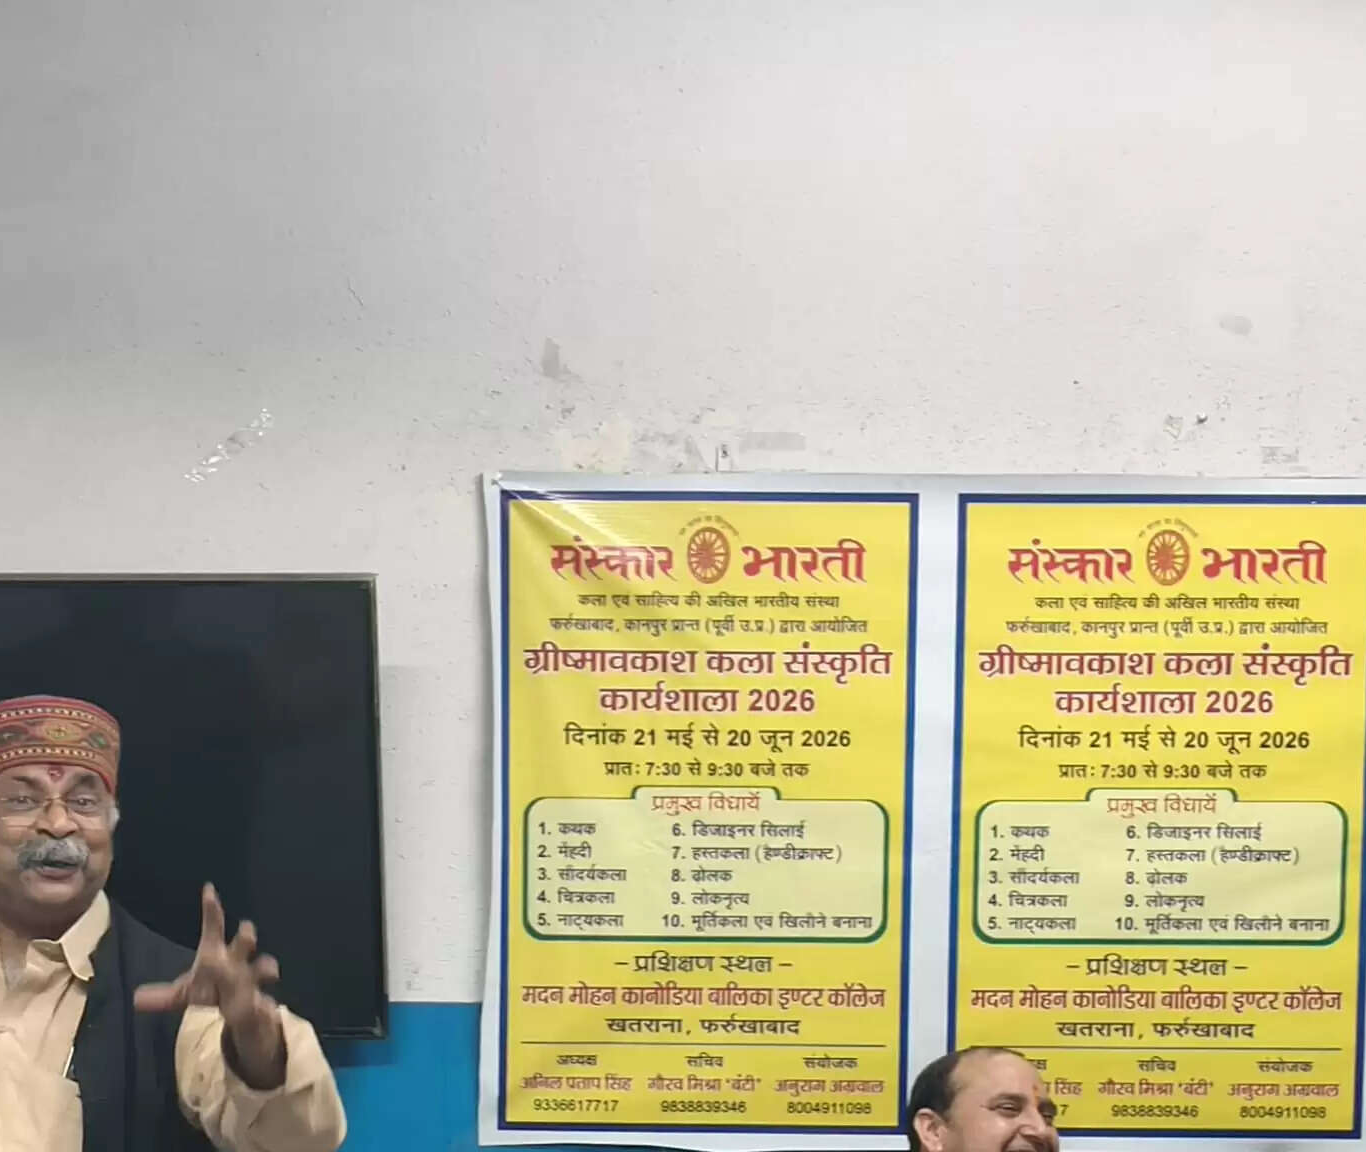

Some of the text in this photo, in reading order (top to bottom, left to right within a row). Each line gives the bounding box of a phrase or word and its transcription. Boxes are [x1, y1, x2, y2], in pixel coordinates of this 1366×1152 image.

[550, 535, 866, 581] संस्कार भारती
[1008, 538, 1327, 583] संस्कार भारती
[1034, 597, 1065, 609] कला
[1141, 592, 1161, 609] की
[1080, 620, 1128, 640] कानपुर
[1270, 616, 1329, 635] आयोजित
[522, 640, 894, 685] ग्रीष्मावकाश कला संस्कृति
[978, 642, 1354, 686] ग्रीष्मावकाश कला संस्कृति
[599, 682, 815, 713] कार्यशाला 2026
[1054, 684, 1273, 714] कार्यशाला 2026
[562, 721, 851, 753] दिनांक 21 मई से 20 जून 2026
[1017, 724, 1310, 755] दिनांक 21 मई से 20 जून 2026
[645, 761, 682, 777] 7:30
[686, 758, 702, 776] से
[707, 762, 744, 777] 9:30
[748, 758, 776, 777] बजे
[780, 763, 810, 777] तक
[1100, 764, 1137, 779] 7:30
[1142, 761, 1158, 779] से
[1163, 764, 1201, 779] 9:30
[1205, 761, 1234, 779] बजे
[1238, 764, 1268, 779] तक
[1106, 798, 1159, 819] प्रमुख
[990, 824, 1050, 839] 1. कथक
[1126, 822, 1262, 841] 6. डिजाइनर सिलाई
[989, 847, 1004, 862] 2.
[1125, 848, 1140, 862] 7.
[1146, 849, 1206, 863] हस्तकला
[988, 870, 1002, 884] 3.
[1124, 868, 1188, 885] 8. ढोलक
[987, 890, 1068, 907] 4. चित्रकला
[1124, 891, 1205, 913] 9. लोकनृत्य
[986, 915, 1003, 930] 5.
[1115, 916, 1139, 931] 10.
[1288, 917, 1330, 932] बनाना
[1086, 952, 1228, 977] प्रशिक्षण स्थल
[971, 989, 1015, 1009] मदन
[1018, 984, 1068, 1010] मोहन
[1232, 991, 1280, 1014] इण्टर
[1282, 985, 1343, 1011] कॉलेज
[1055, 1022, 1143, 1040] खतराना,
[1137, 1056, 1177, 1072] सचिव
